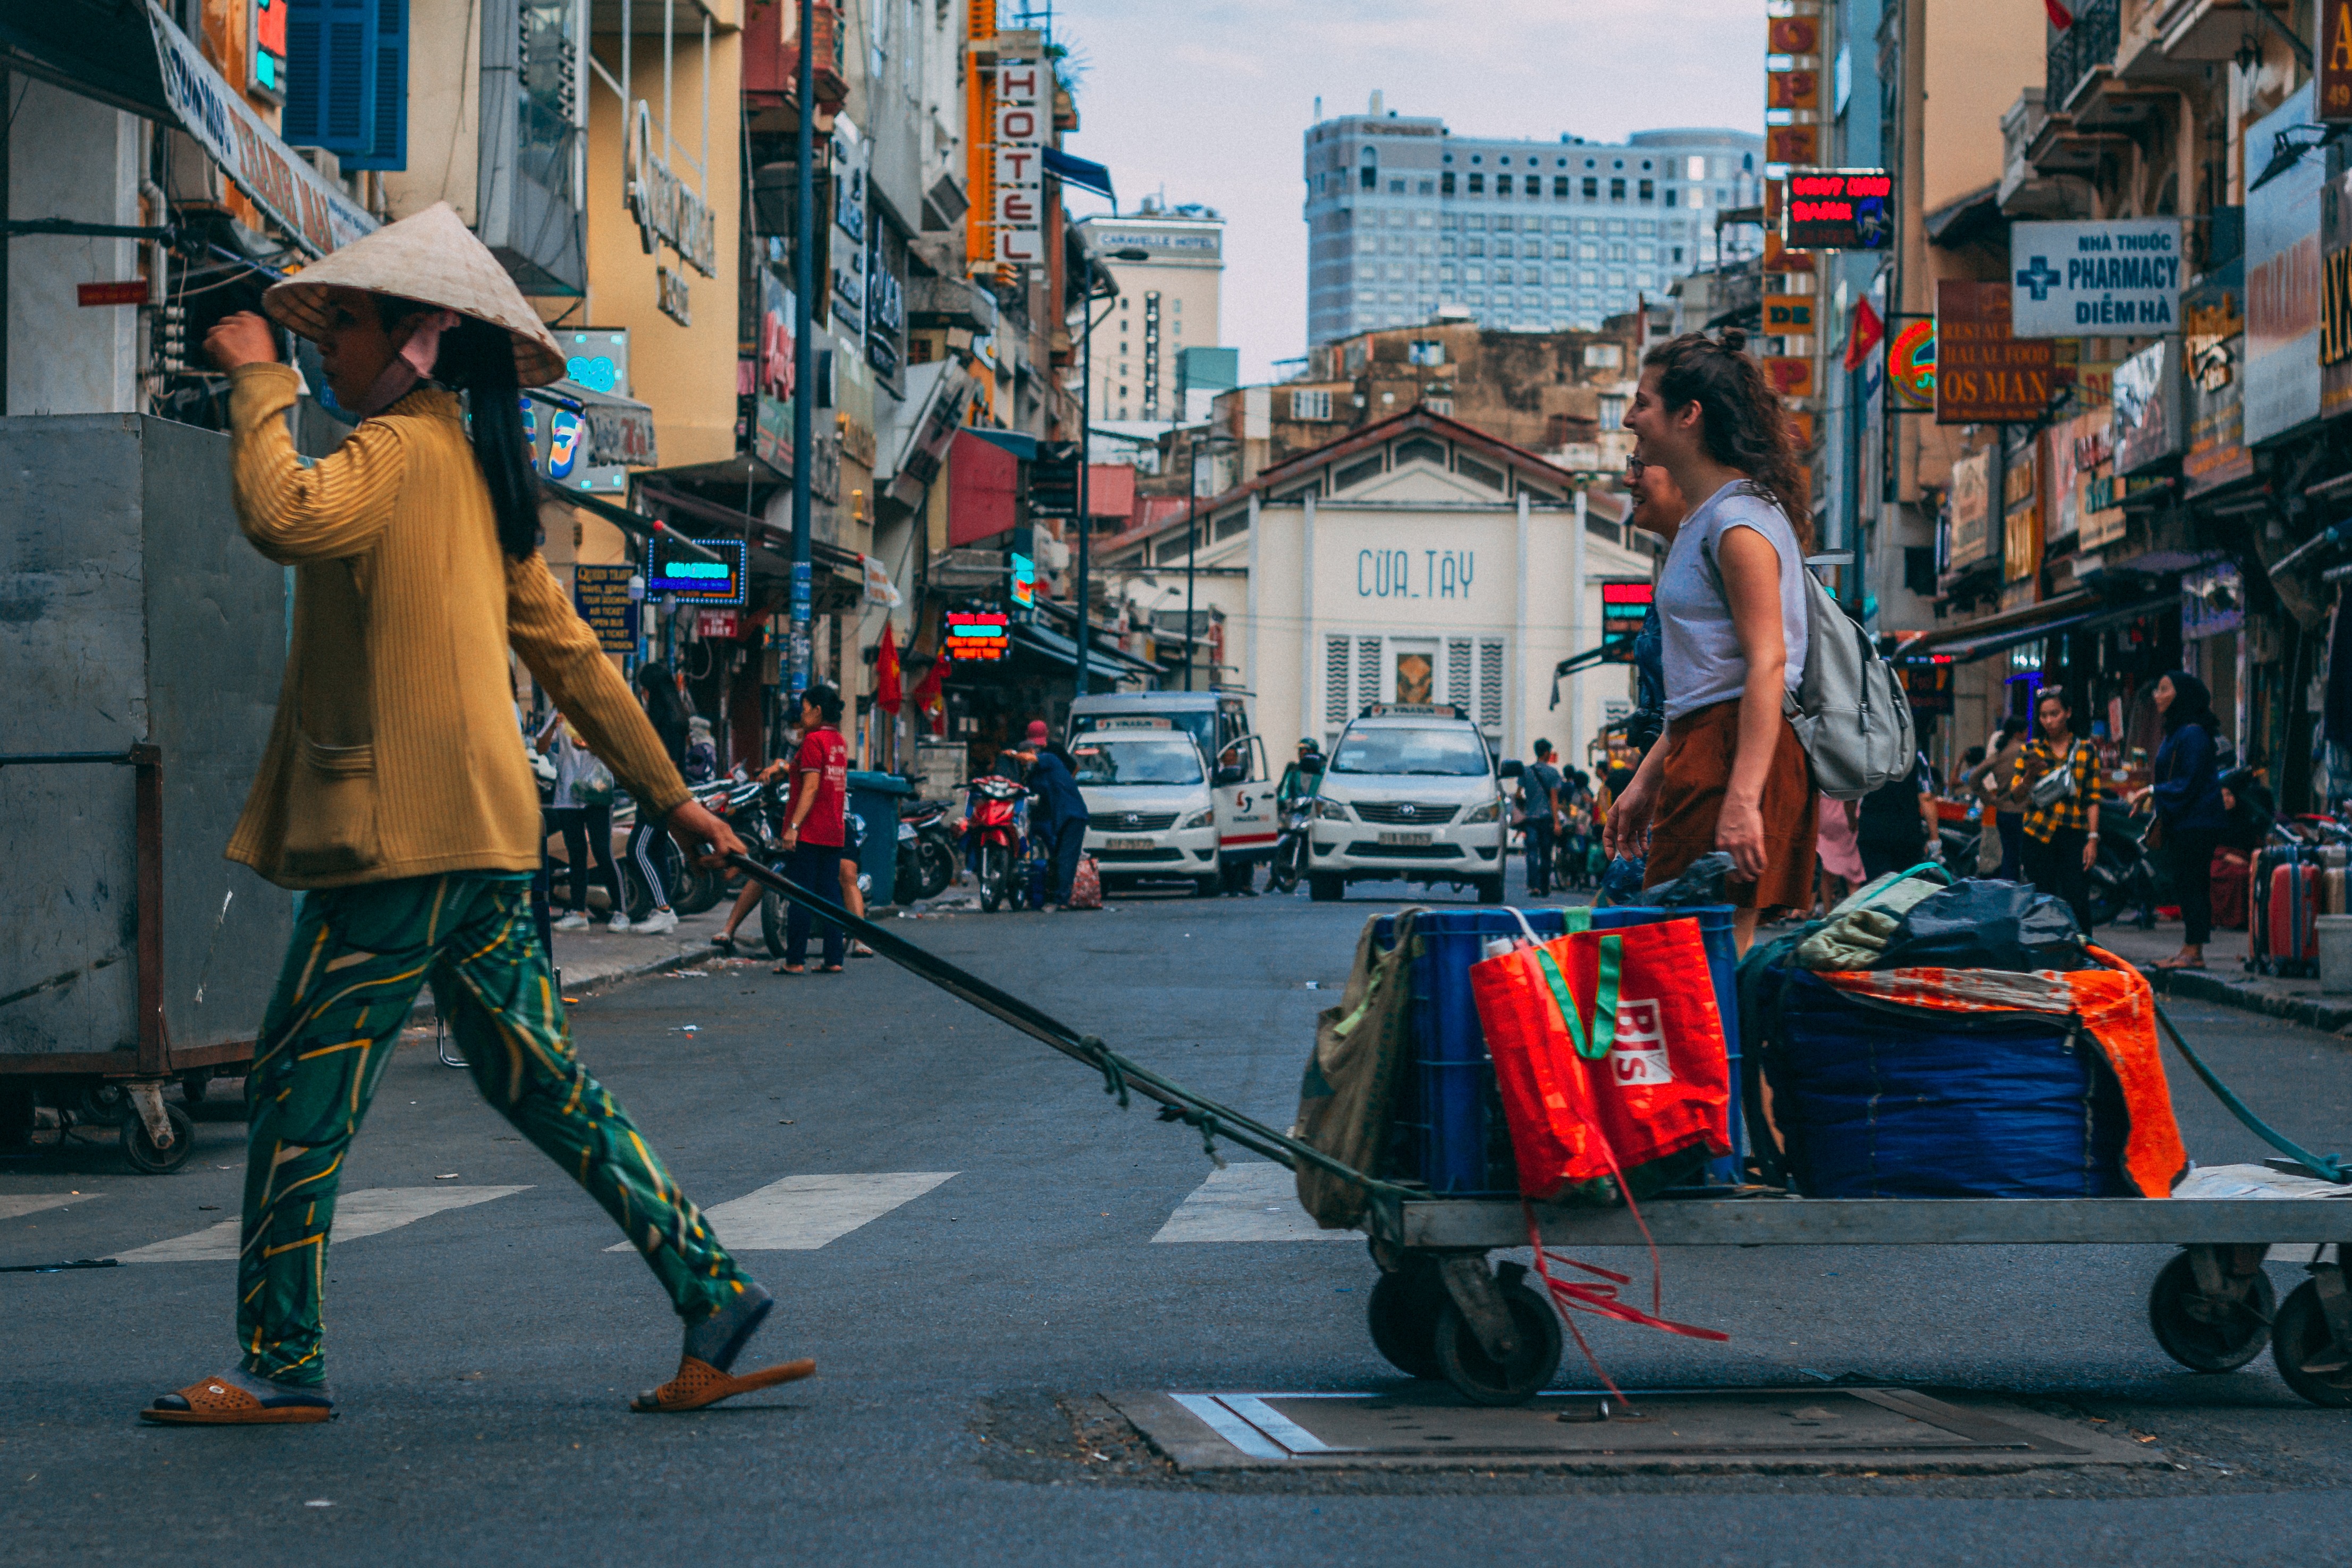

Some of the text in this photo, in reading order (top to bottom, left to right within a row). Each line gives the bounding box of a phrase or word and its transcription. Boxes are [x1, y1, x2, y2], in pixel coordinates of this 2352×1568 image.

[1003, 70, 1035, 259] HOTEL
[1175, 237, 1213, 249] HOTEL
[2068, 256, 2179, 290] PHARMACY
[1770, 306, 1810, 324] DE
